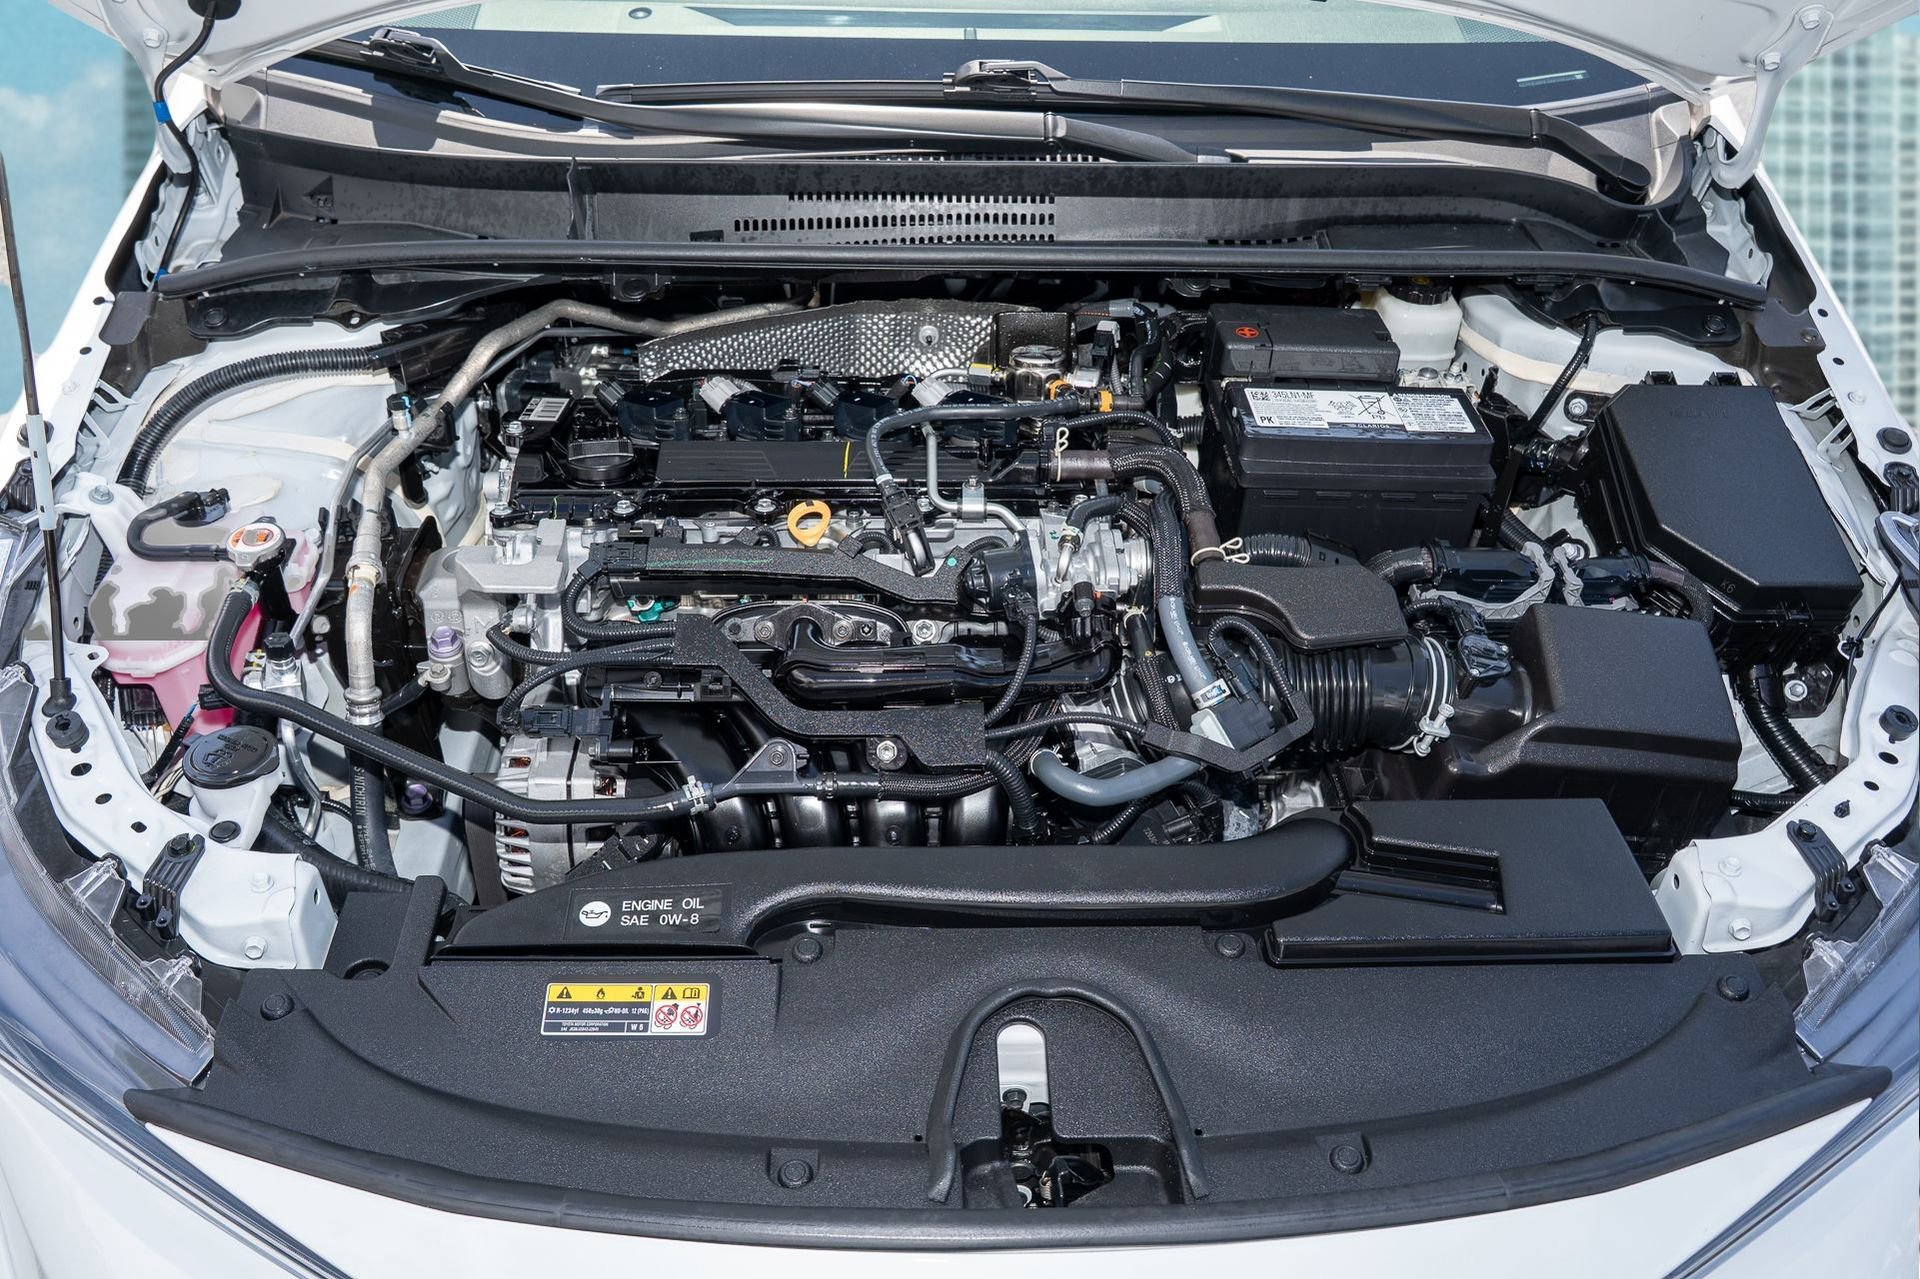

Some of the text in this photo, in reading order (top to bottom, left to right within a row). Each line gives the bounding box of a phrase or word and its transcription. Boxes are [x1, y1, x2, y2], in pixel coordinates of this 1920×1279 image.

[1260, 415, 1275, 425] PK
[621, 897, 705, 912] ENGINE OIL
[620, 912, 700, 926] SAE 0W-8
